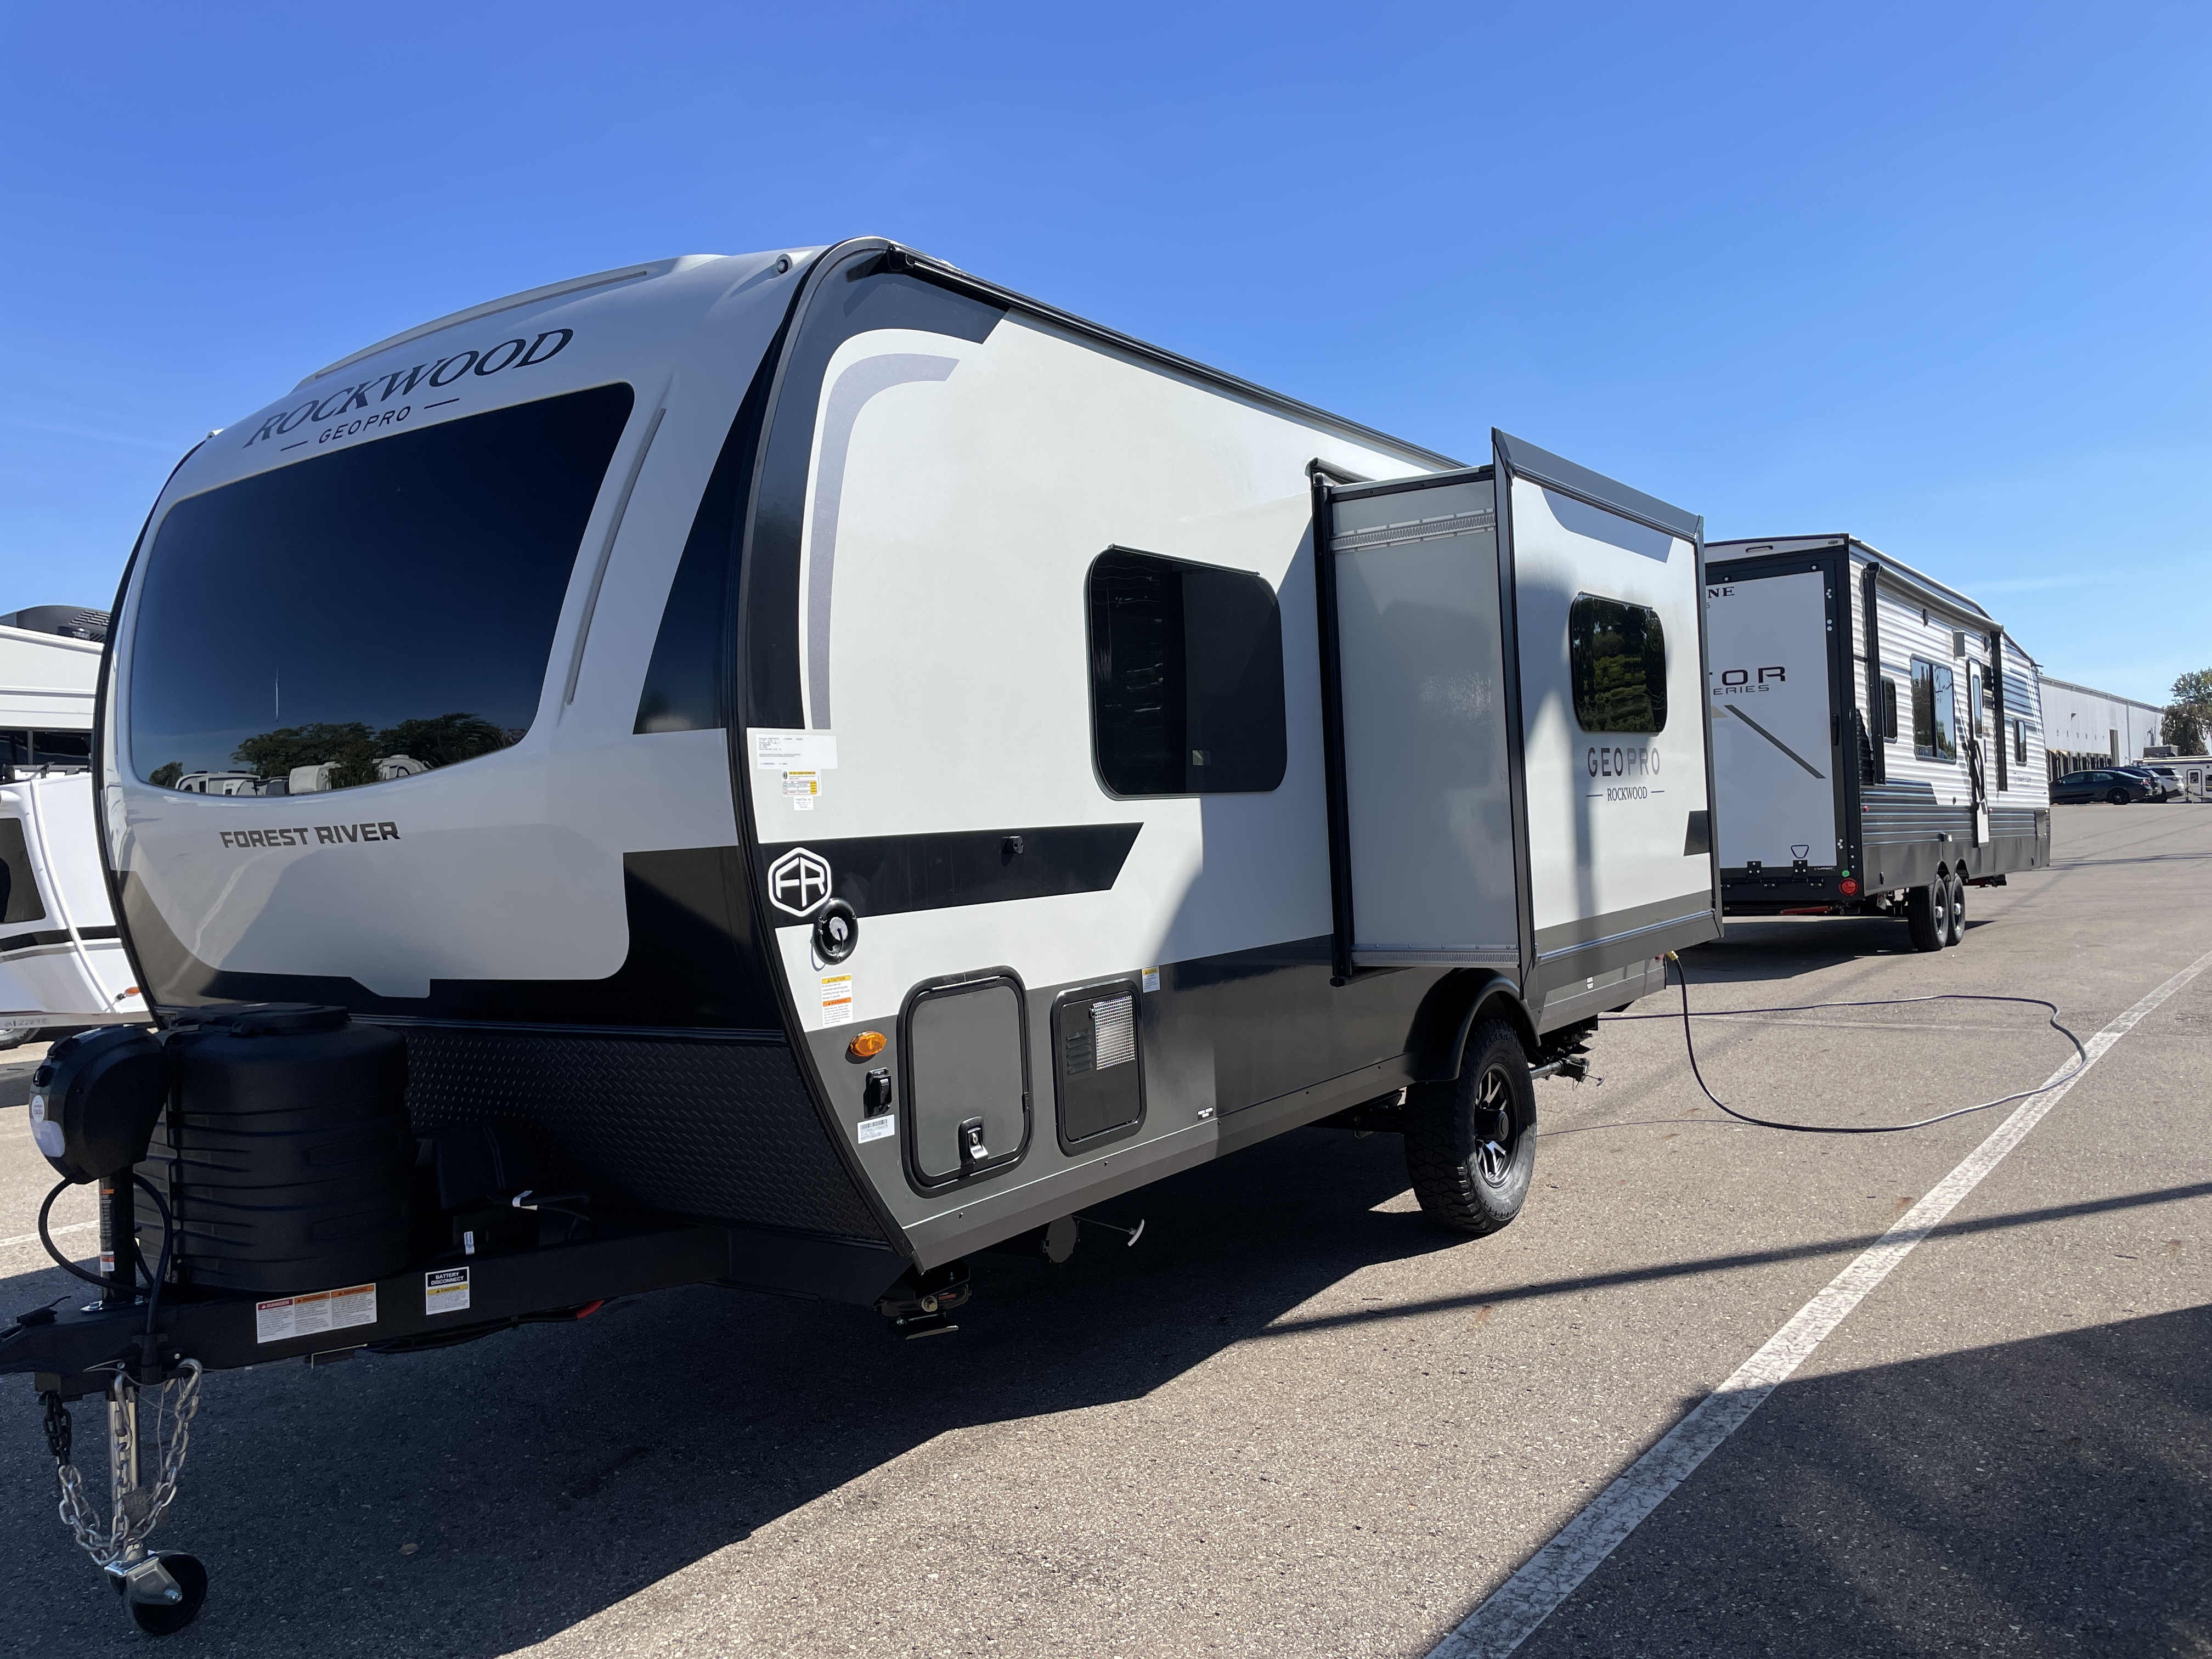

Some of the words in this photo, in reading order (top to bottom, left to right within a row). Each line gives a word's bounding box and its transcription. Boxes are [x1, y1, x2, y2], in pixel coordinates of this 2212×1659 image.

[242, 328, 574, 449] ROCKWOOD
[318, 406, 411, 444] GEOPRO
[1709, 666, 1786, 686] OR
[1587, 747, 1660, 777] GEOPRO
[1607, 786, 1647, 801] ROCKWOOD
[219, 827, 308, 848] FOREST
[313, 821, 402, 844] RIVER
[431, 1276, 465, 1285] DISCONNECT
[435, 1271, 460, 1280] BATTERY
[267, 1300, 290, 1308] DANGER
